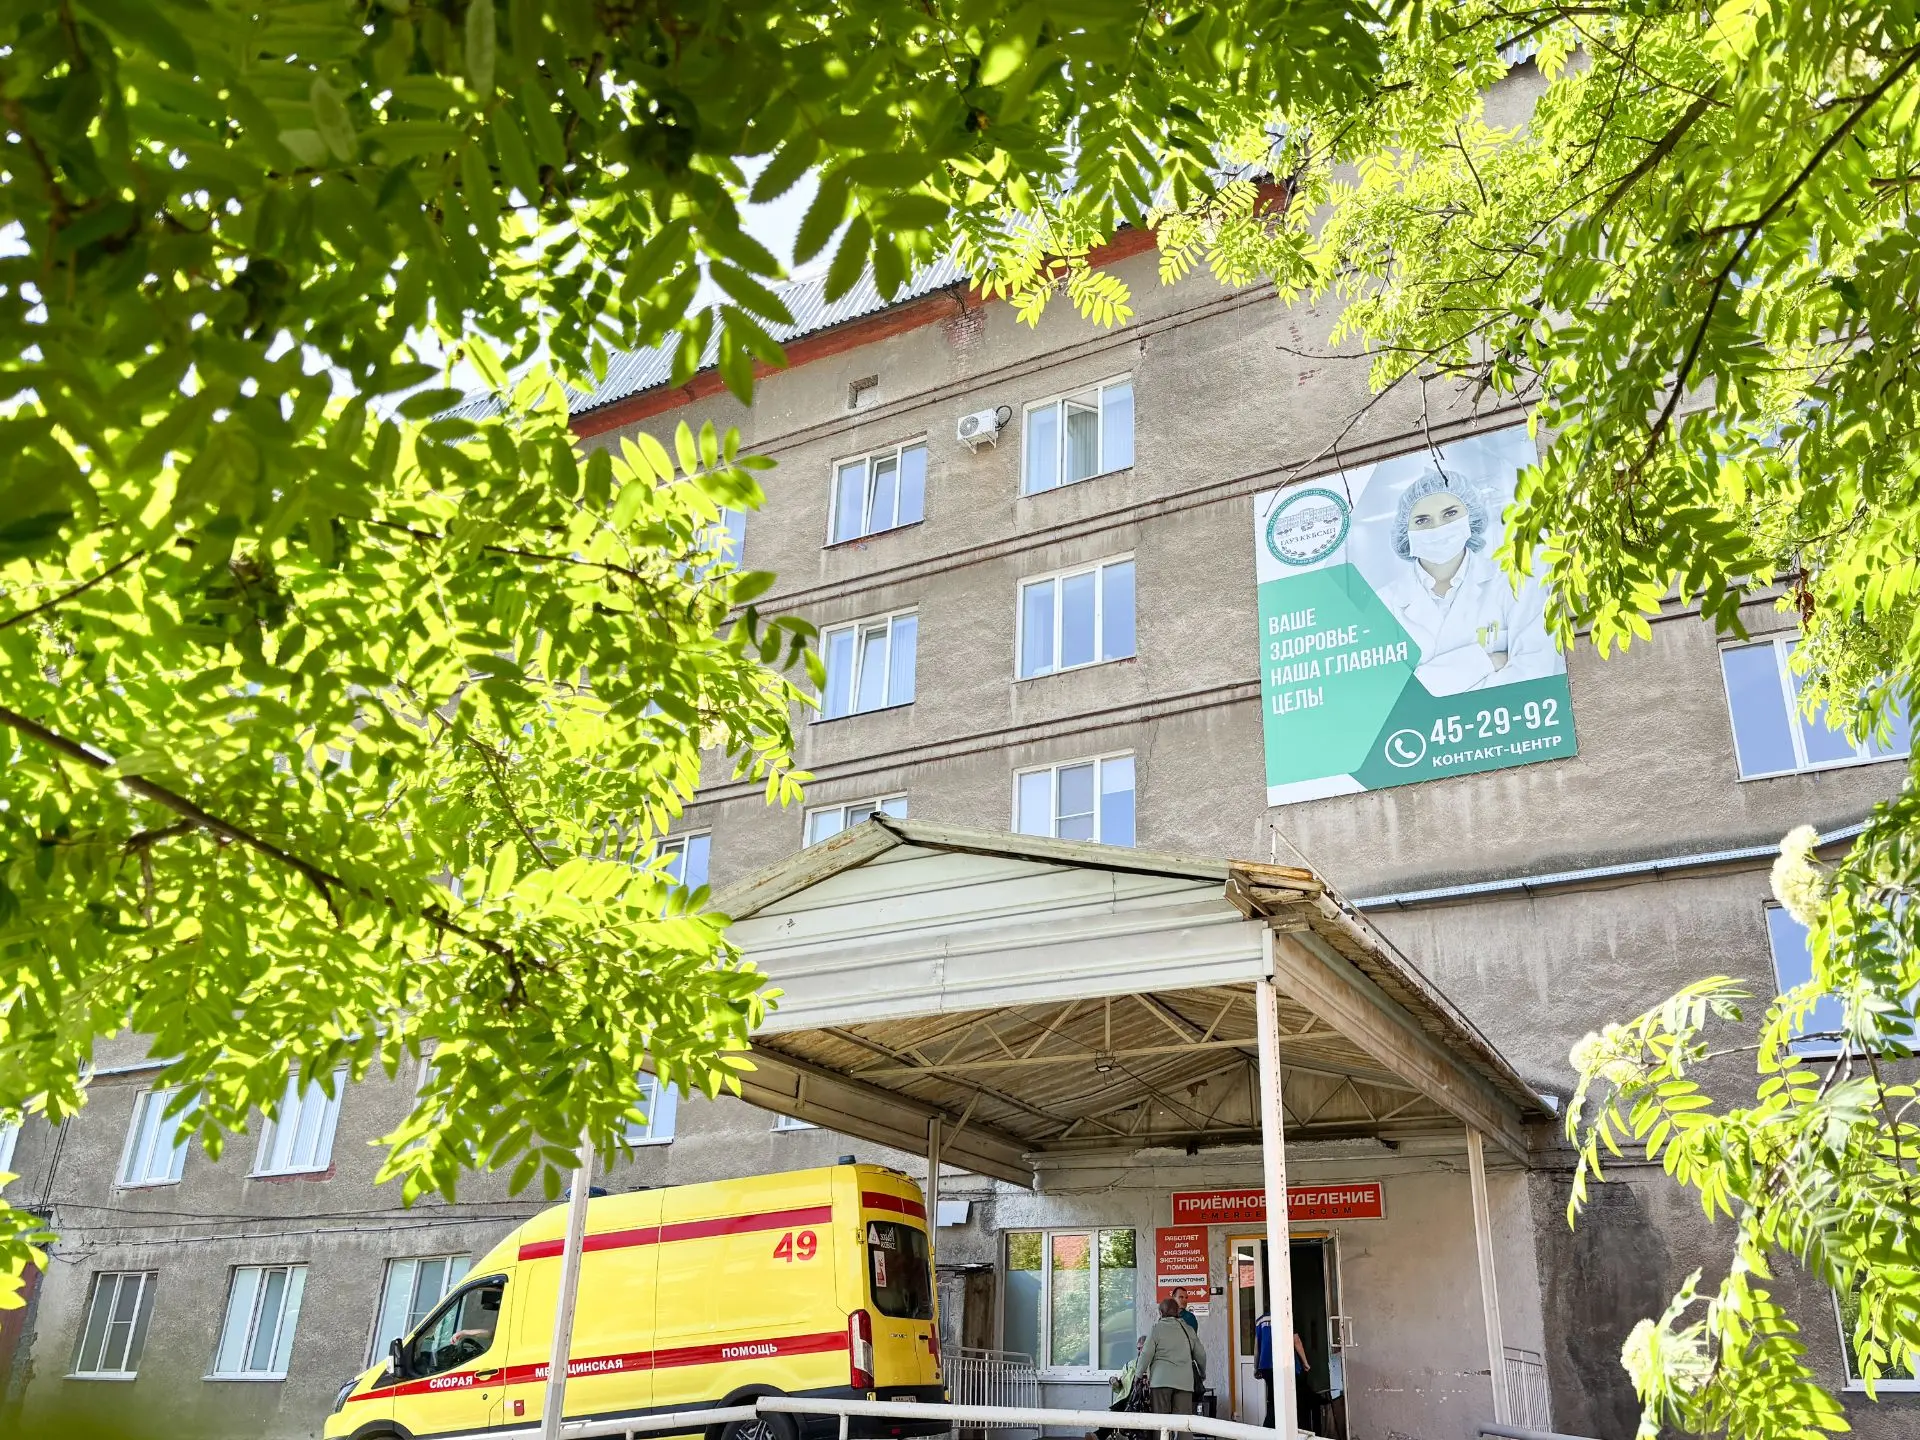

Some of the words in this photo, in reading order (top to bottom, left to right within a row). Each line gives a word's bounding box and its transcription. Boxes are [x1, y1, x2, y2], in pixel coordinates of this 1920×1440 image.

[1268, 607, 1316, 636] ВАШЕ
[1270, 624, 1359, 661] ЗДОРОВЬЕ
[1271, 659, 1321, 687] НАША
[1324, 641, 1408, 676] ГЛАВНАЯ
[1272, 686, 1324, 716] ЦЕЛЬ!
[1430, 698, 1560, 745] 45-29-92
[1432, 735, 1562, 767] КОНТАКТ-ЦЕНТР
[1178, 1195, 1266, 1211] ПРИЁМНОЕ
[1287, 1190, 1376, 1207] ТДЕЛЕНИЕ
[1201, 1208, 1294, 1220] EMERGEY
[1309, 1206, 1352, 1216] ROOM
[773, 1230, 817, 1263] 49
[1159, 1255, 1205, 1264] ЭКСТРЕННОЙ
[429, 1375, 473, 1389] СКОРАЯ
[535, 1358, 624, 1378] МЕЦИНСКАЯ
[721, 1343, 778, 1358] ПОМОЩЬ
